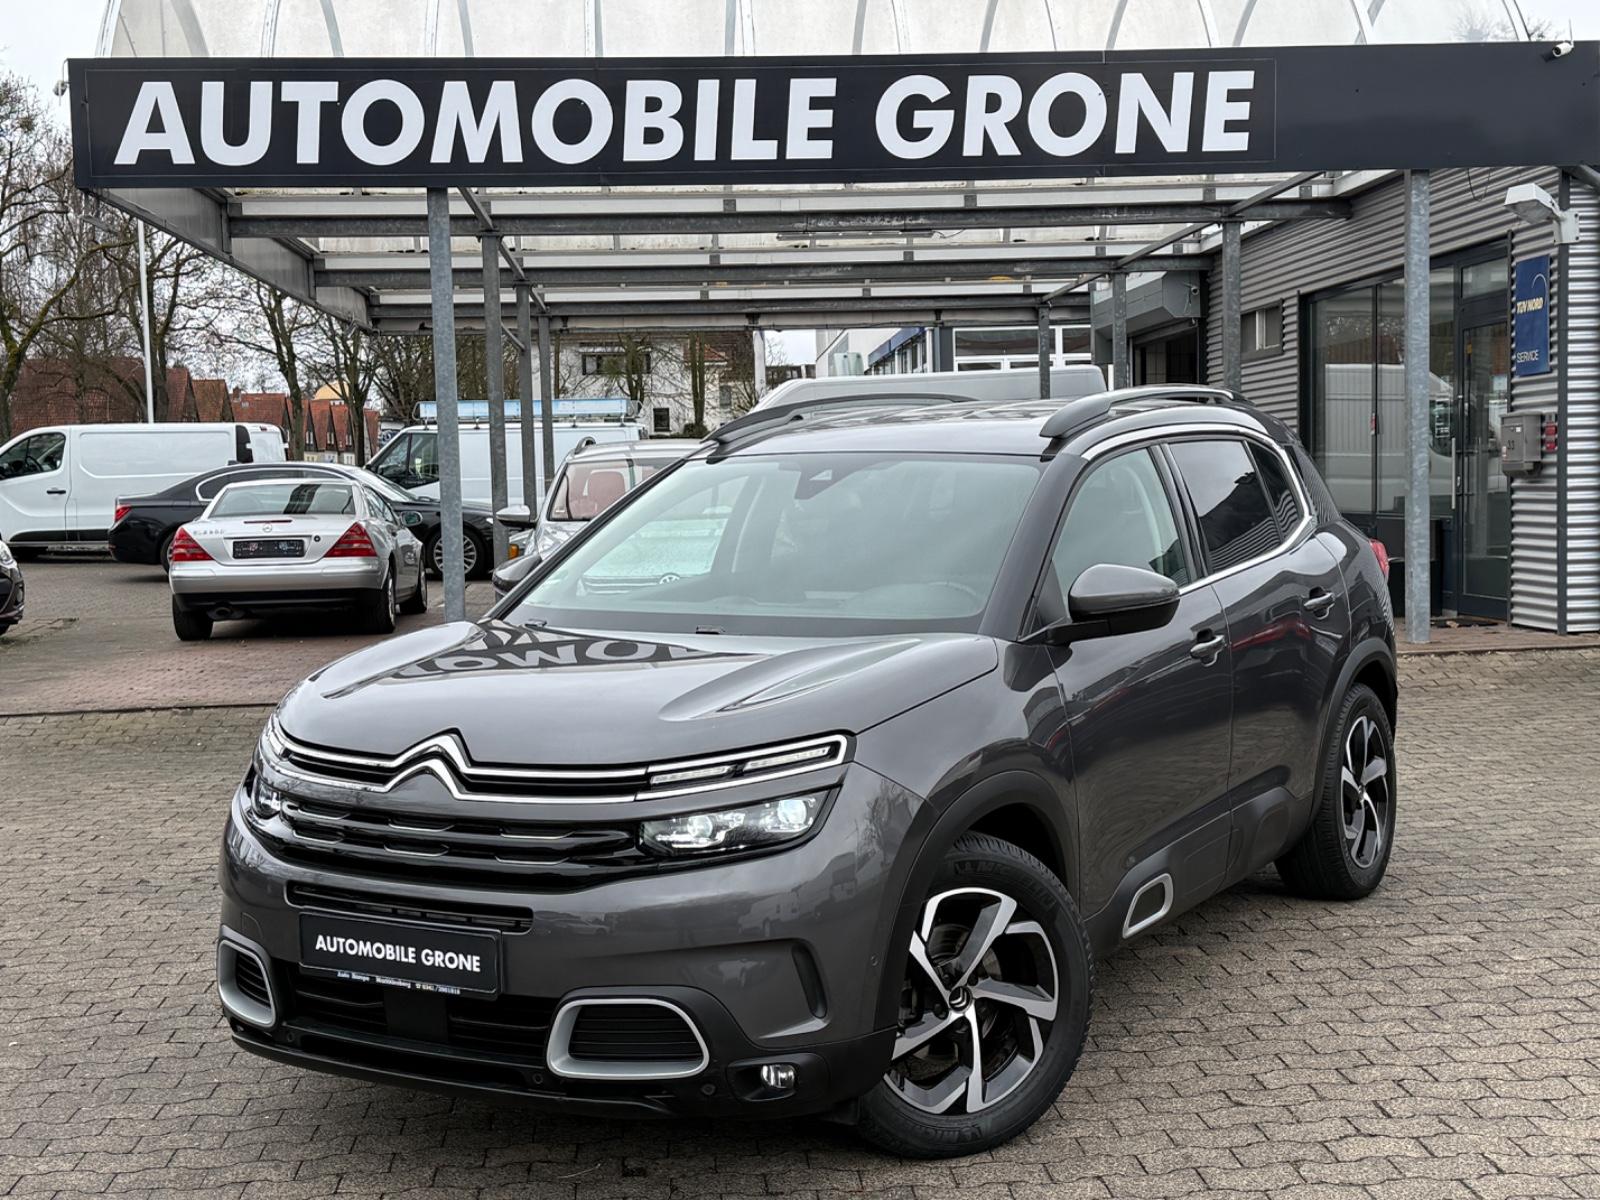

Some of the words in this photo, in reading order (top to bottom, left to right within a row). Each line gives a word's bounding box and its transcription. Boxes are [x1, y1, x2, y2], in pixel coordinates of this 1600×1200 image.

[113, 77, 838, 167] AUTOMOBILE
[875, 70, 1256, 159] GRONE
[1516, 349, 1539, 363] SERVICE
[314, 934, 416, 964] AUTOMOBILE
[420, 948, 481, 973] GRONE
